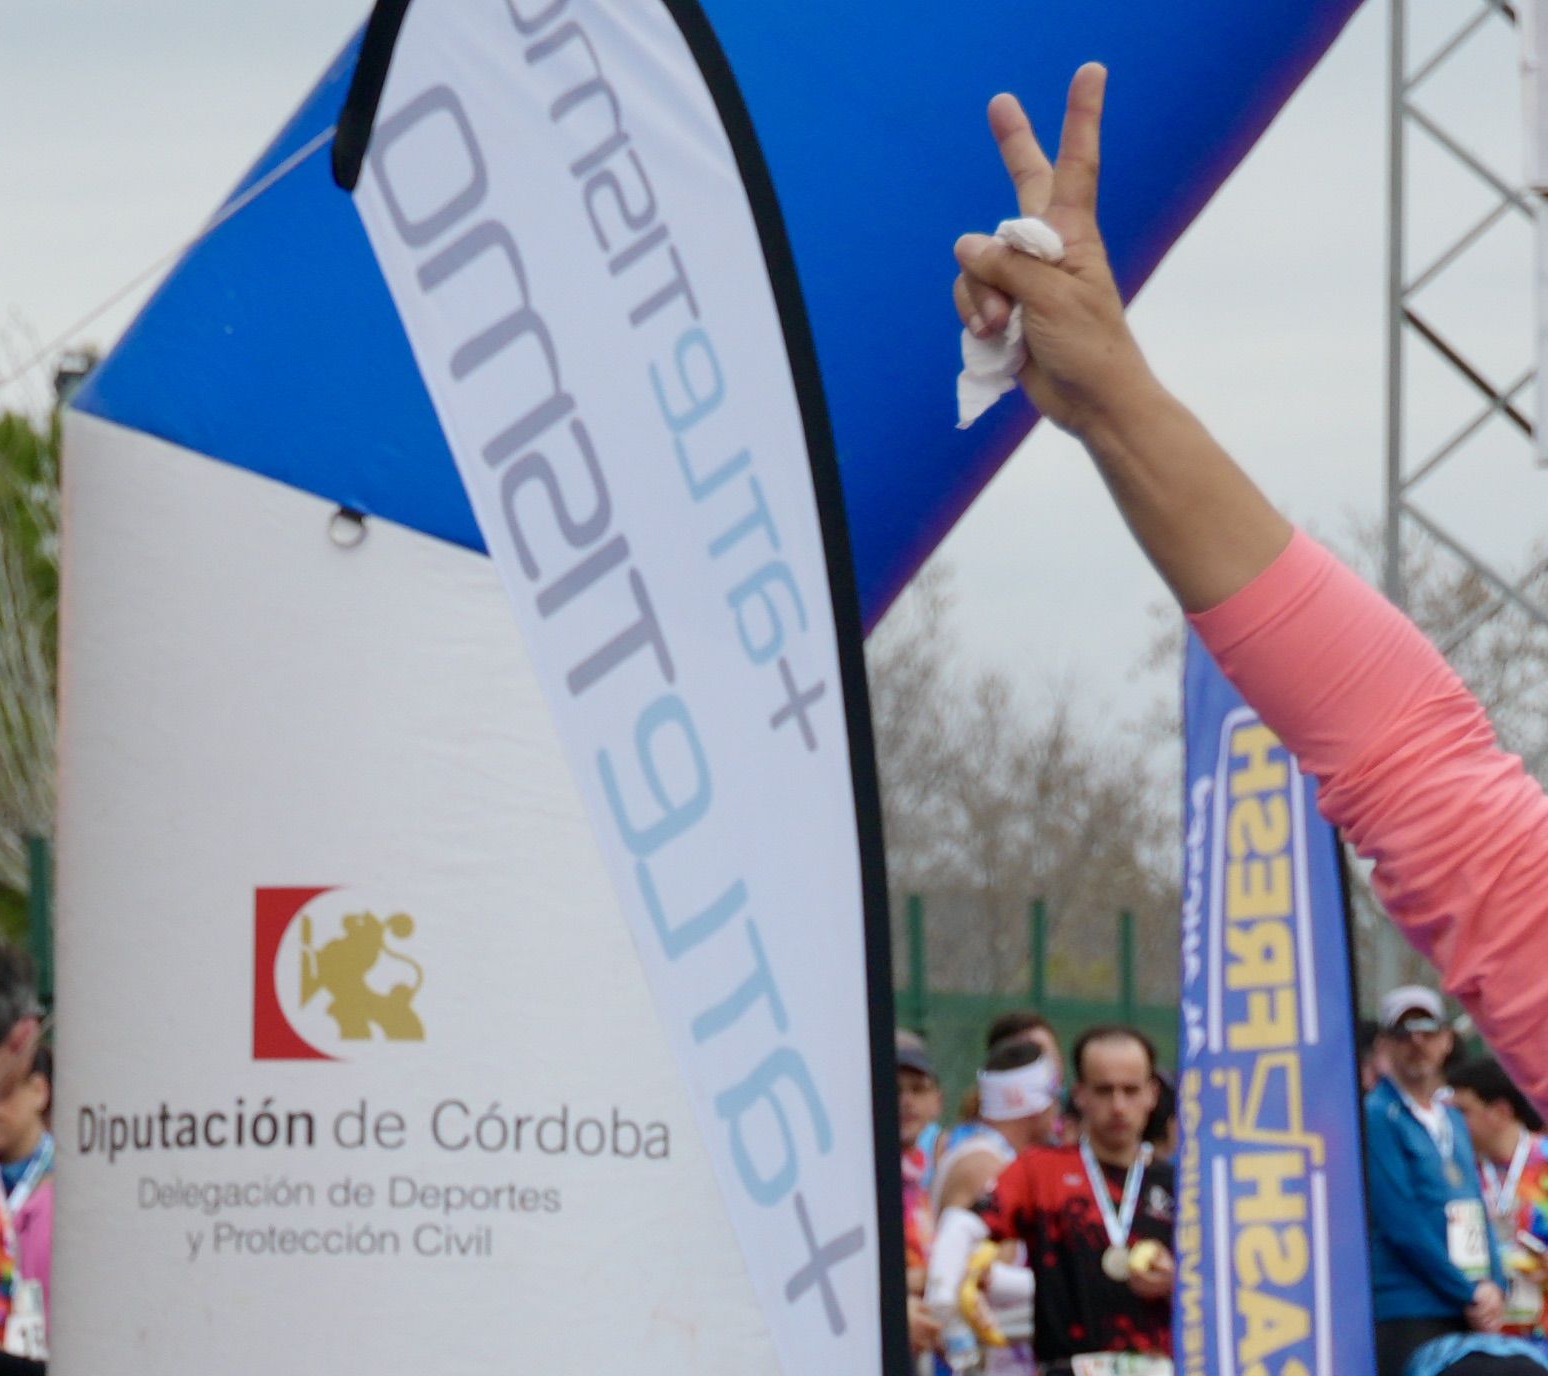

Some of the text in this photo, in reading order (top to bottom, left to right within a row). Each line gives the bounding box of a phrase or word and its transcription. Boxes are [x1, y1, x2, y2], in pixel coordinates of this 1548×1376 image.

[77, 1099, 672, 1164] Diputación de Córdoba
[137, 1176, 563, 1217] Delegación de Deportes
[186, 1222, 494, 1263] y Protección Civil
